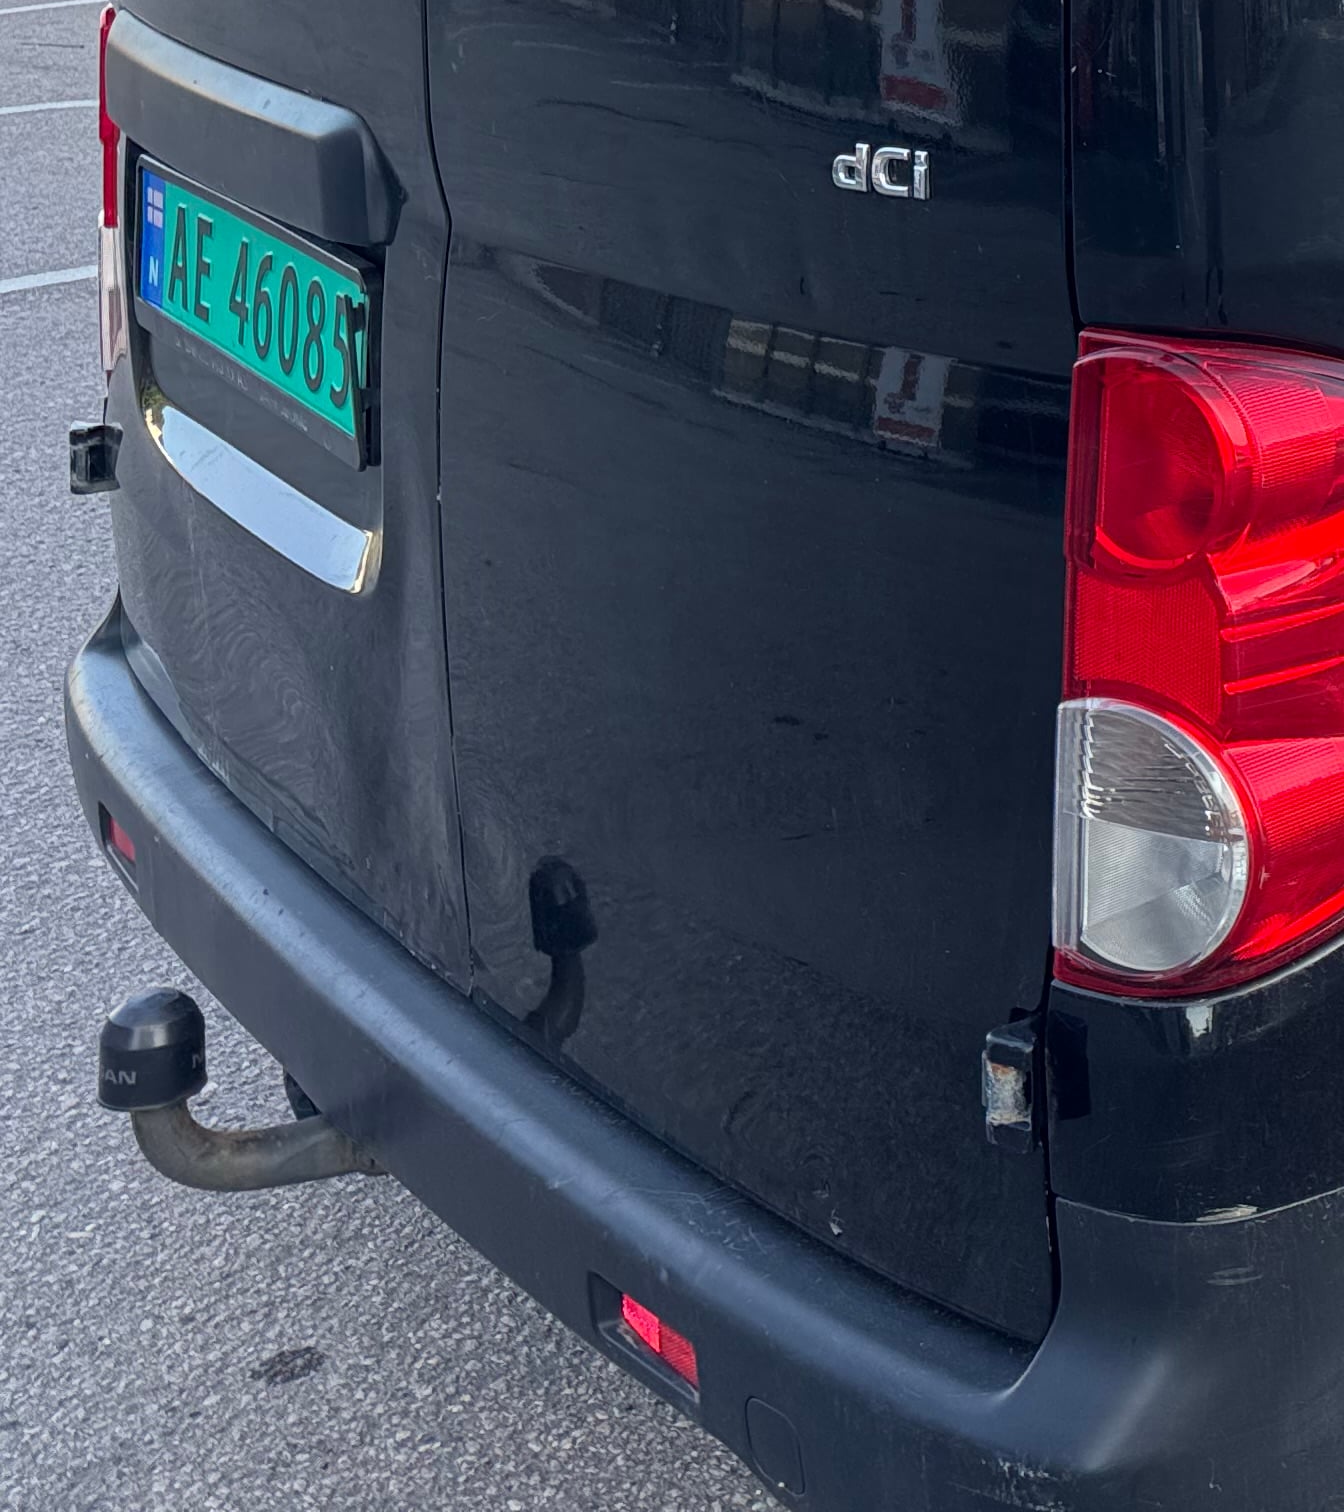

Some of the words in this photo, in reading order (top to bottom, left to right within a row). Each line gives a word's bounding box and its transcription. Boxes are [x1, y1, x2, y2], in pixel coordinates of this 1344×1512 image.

[832, 142, 930, 200] dCi
[149, 255, 160, 288] N
[167, 202, 214, 324] AE
[228, 237, 354, 409] 46085
